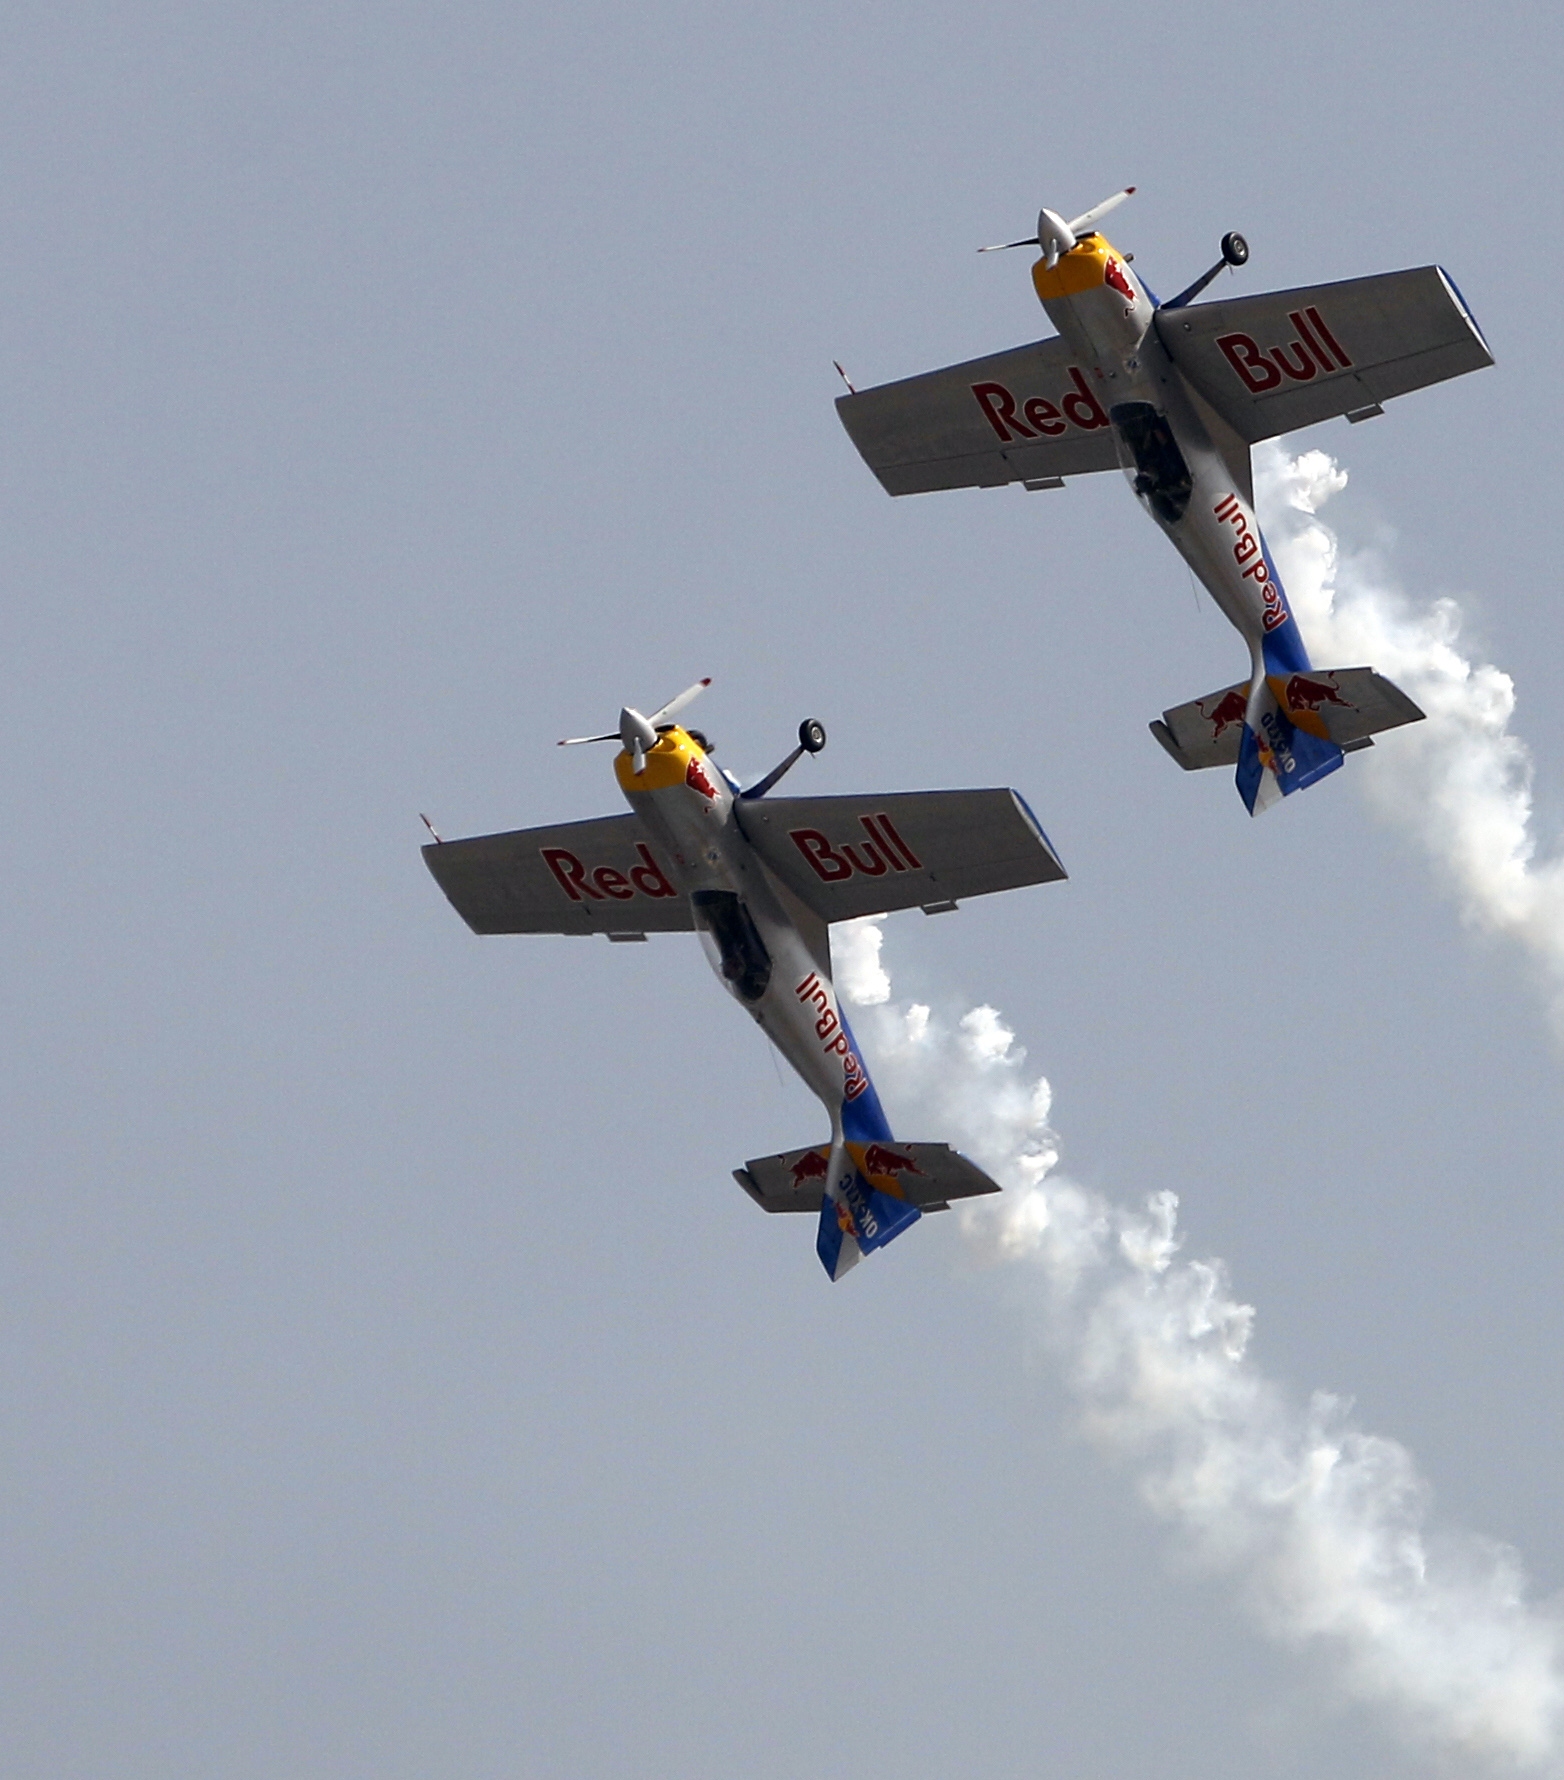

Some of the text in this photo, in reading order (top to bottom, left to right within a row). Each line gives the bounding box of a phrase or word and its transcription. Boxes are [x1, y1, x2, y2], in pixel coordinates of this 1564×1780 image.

[970, 306, 1353, 443] Red Bull
[539, 813, 923, 902] Red Bull
